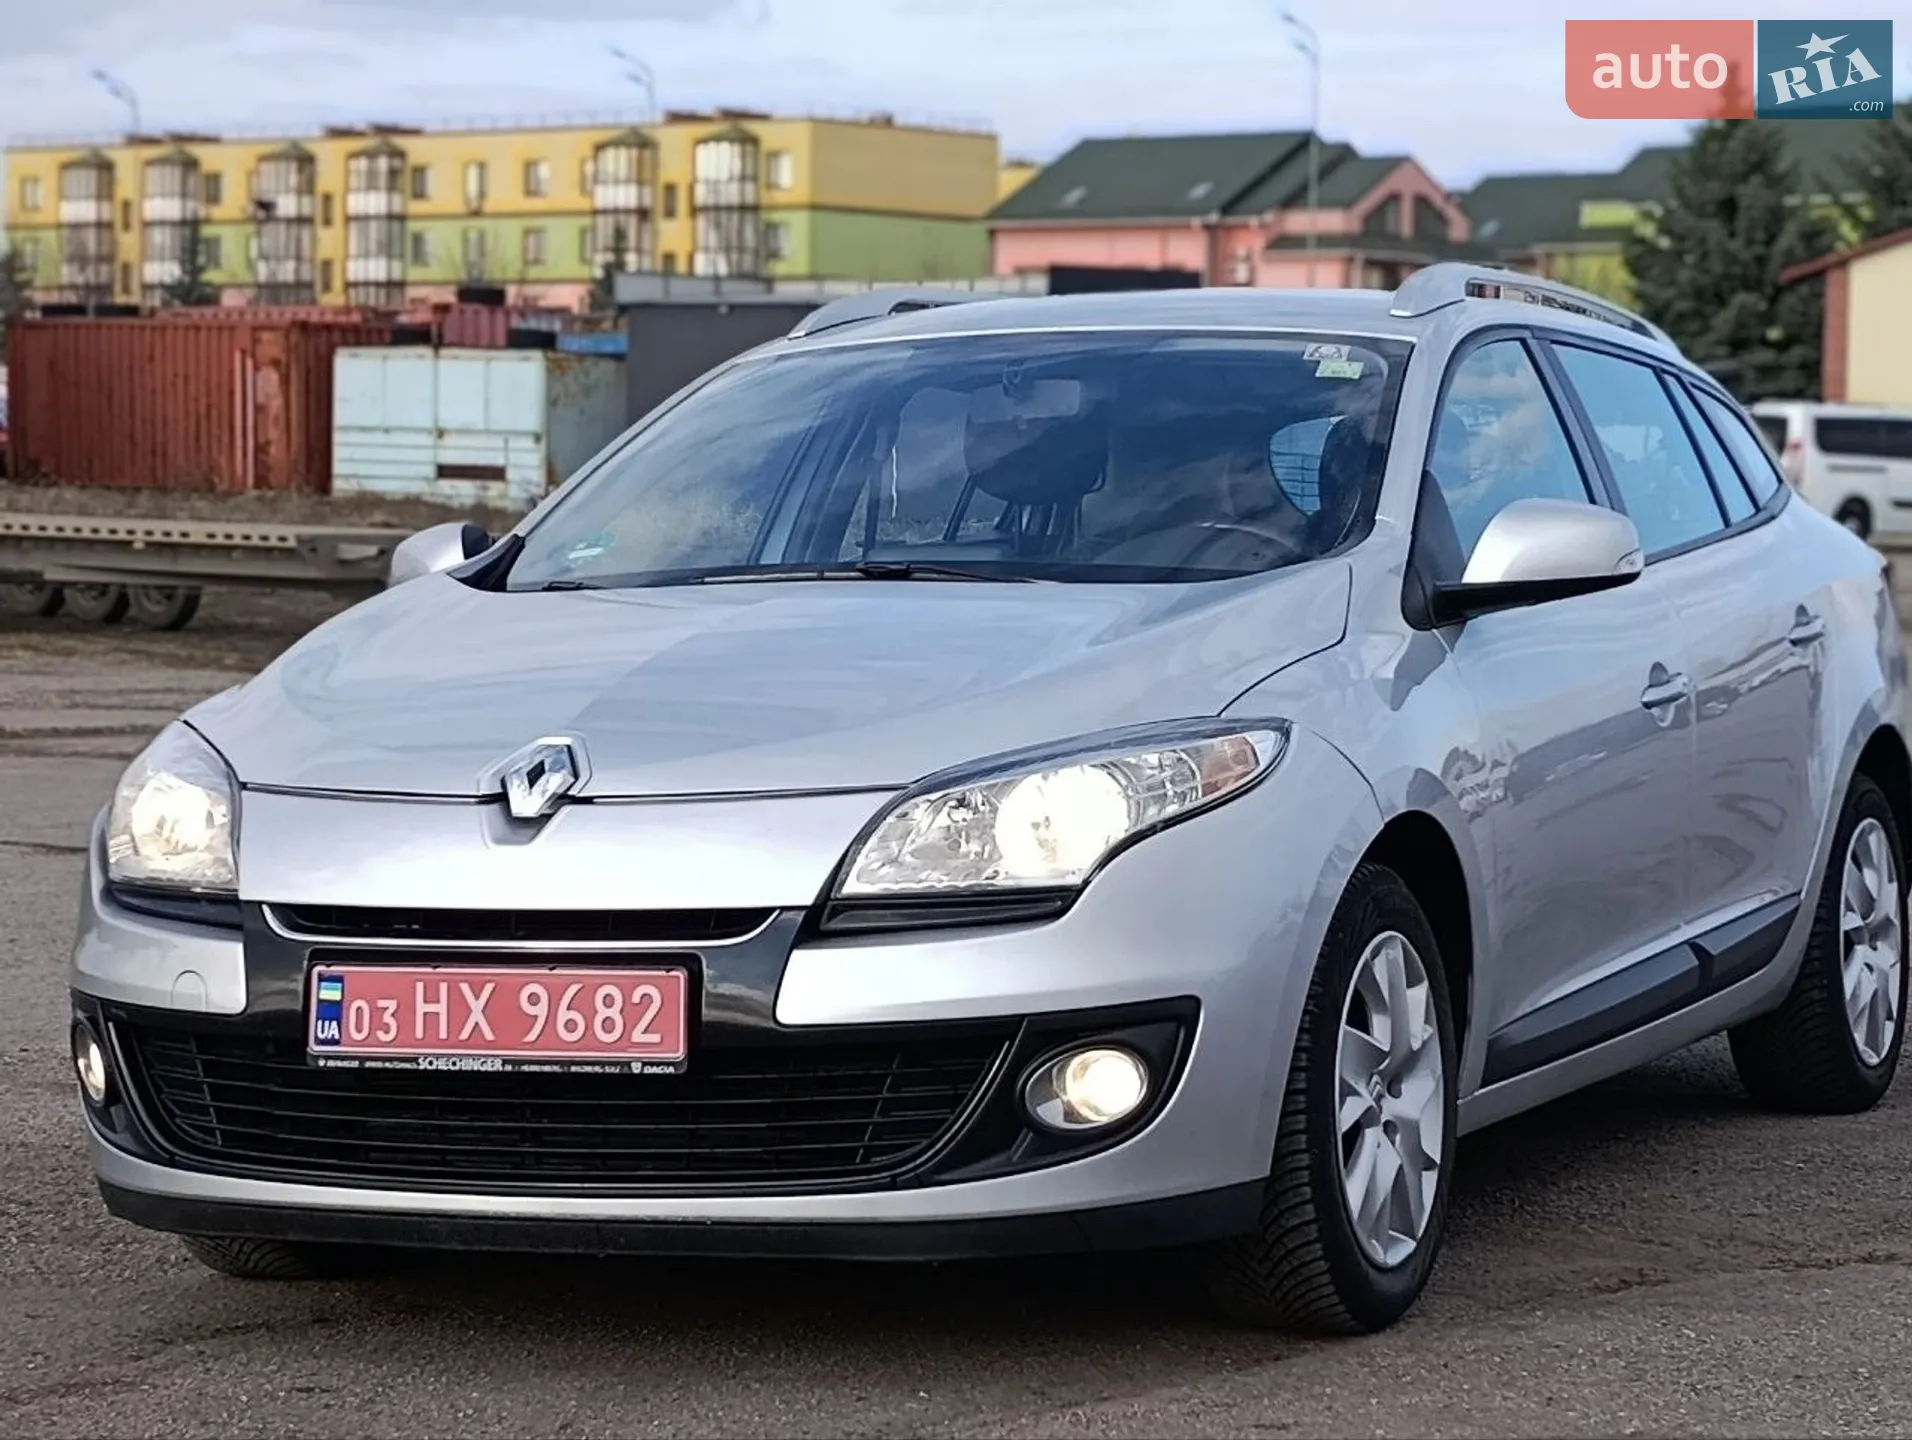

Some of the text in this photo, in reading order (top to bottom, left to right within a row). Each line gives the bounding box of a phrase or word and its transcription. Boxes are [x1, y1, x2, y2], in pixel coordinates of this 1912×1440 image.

[348, 981, 662, 1045] 03 HX 9682
[316, 1020, 341, 1040] UA
[418, 1056, 503, 1071] SCHECHINGER
[643, 1063, 675, 1074] DACIA
